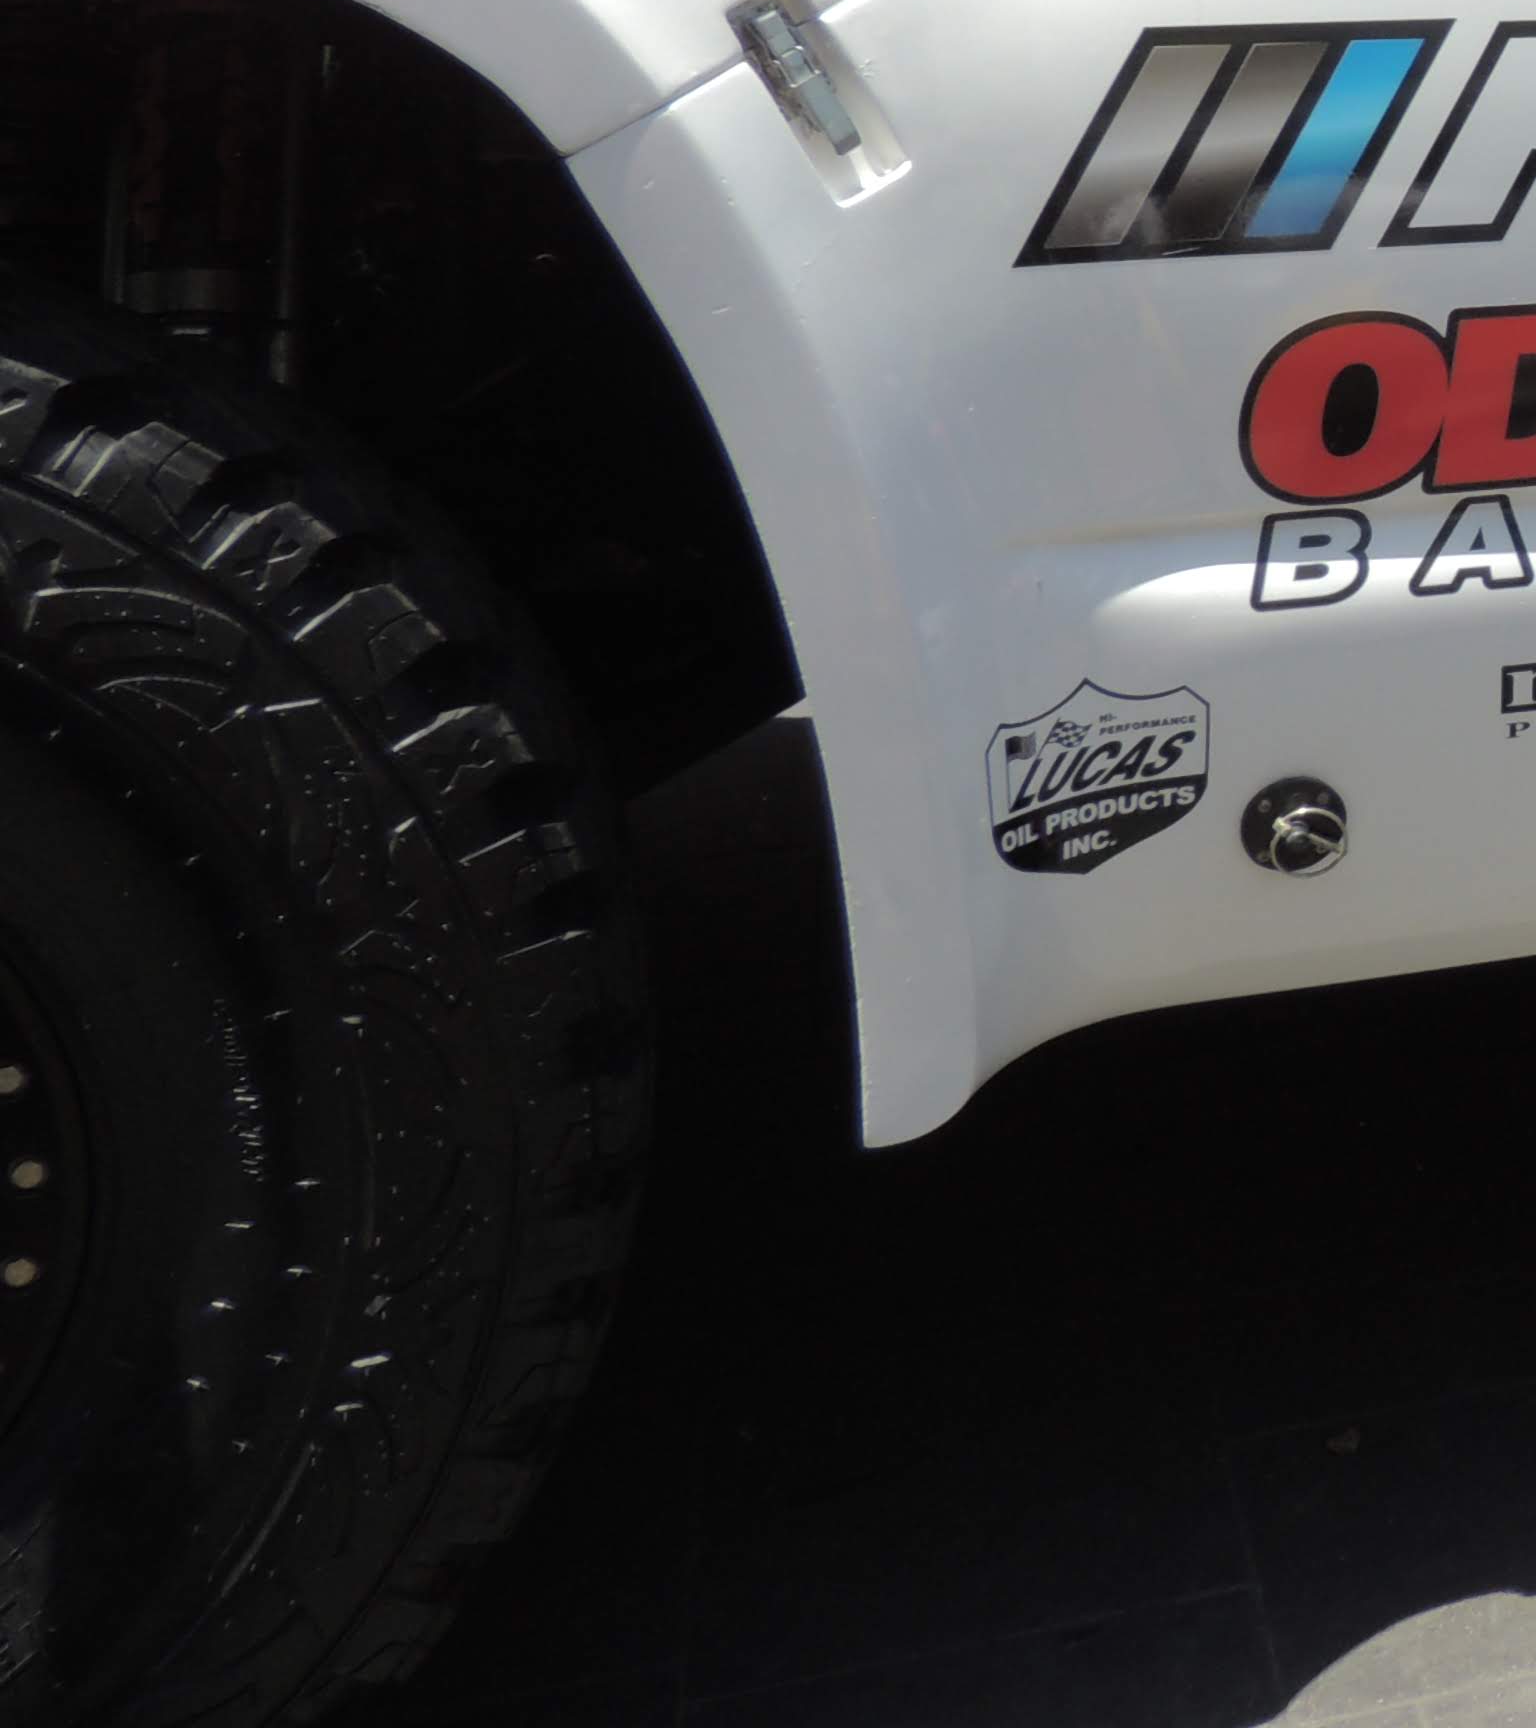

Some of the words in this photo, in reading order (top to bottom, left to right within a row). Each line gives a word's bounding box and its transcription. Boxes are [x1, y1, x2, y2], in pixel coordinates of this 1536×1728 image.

[1098, 714, 1198, 737] PERFORMANCE
[1008, 729, 1198, 814] LUCAS
[1001, 824, 1040, 854] OIL
[1045, 784, 1197, 836] PRODUCTS
[1061, 830, 1118, 862] INC.
